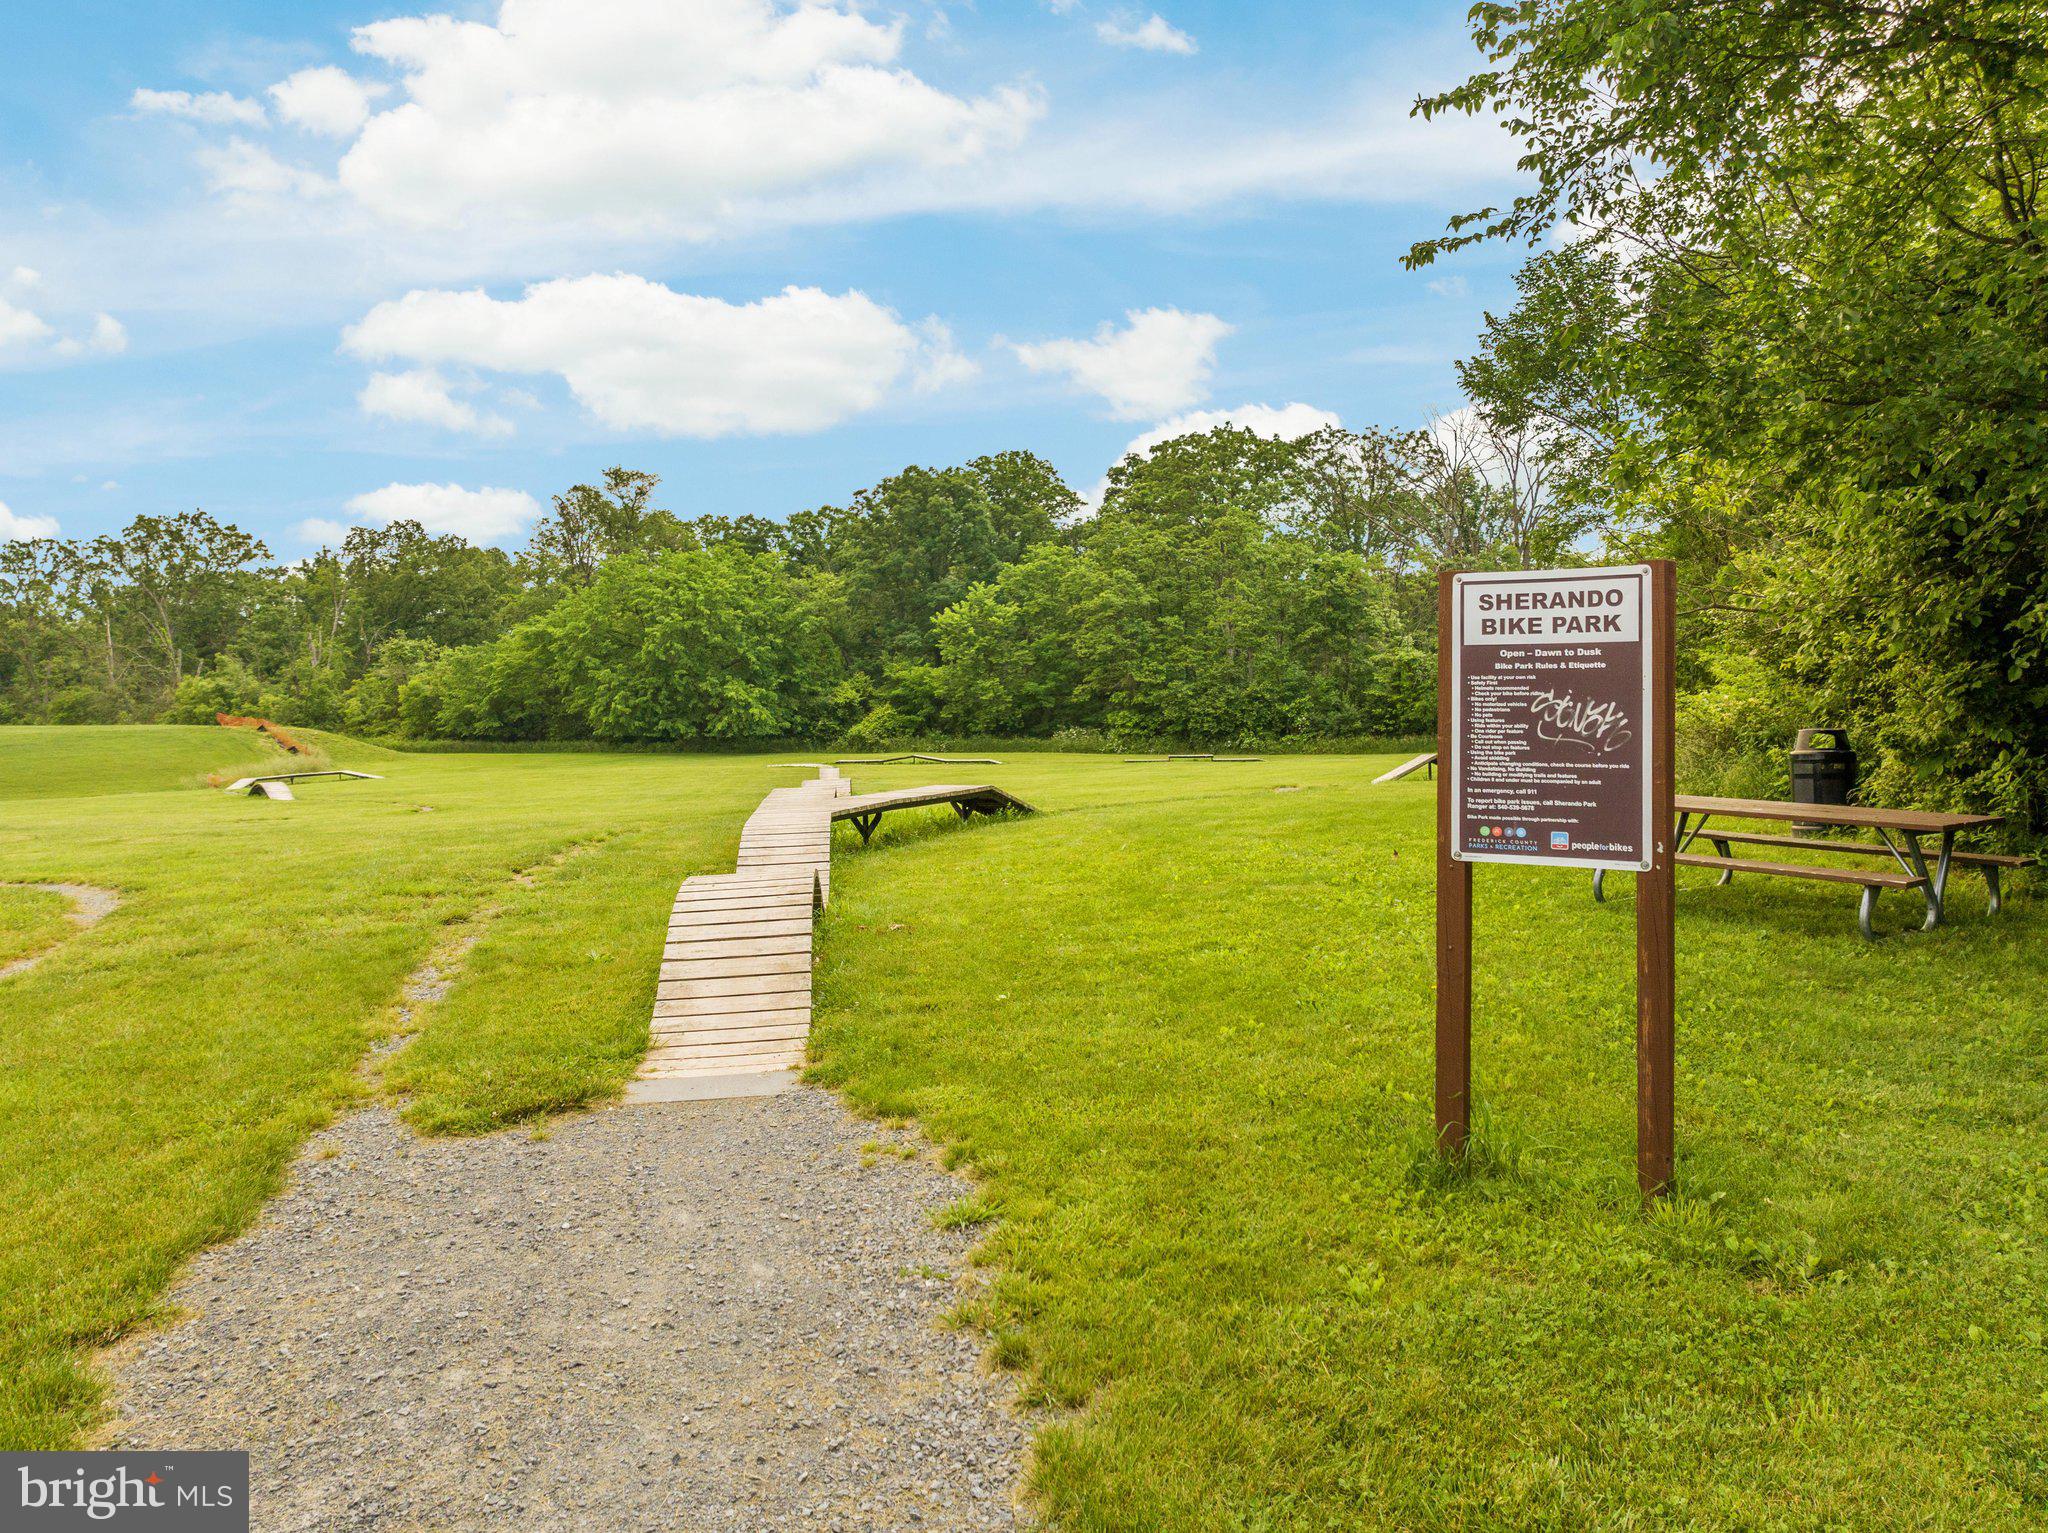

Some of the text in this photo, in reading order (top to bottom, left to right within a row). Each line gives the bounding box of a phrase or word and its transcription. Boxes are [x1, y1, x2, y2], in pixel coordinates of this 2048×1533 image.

[1479, 589, 1623, 611] SHERANDO
[1482, 614, 1622, 635] BIKE PARK
[1500, 650, 1525, 658] Open
[1572, 842, 1633, 852] peopleforbikes
